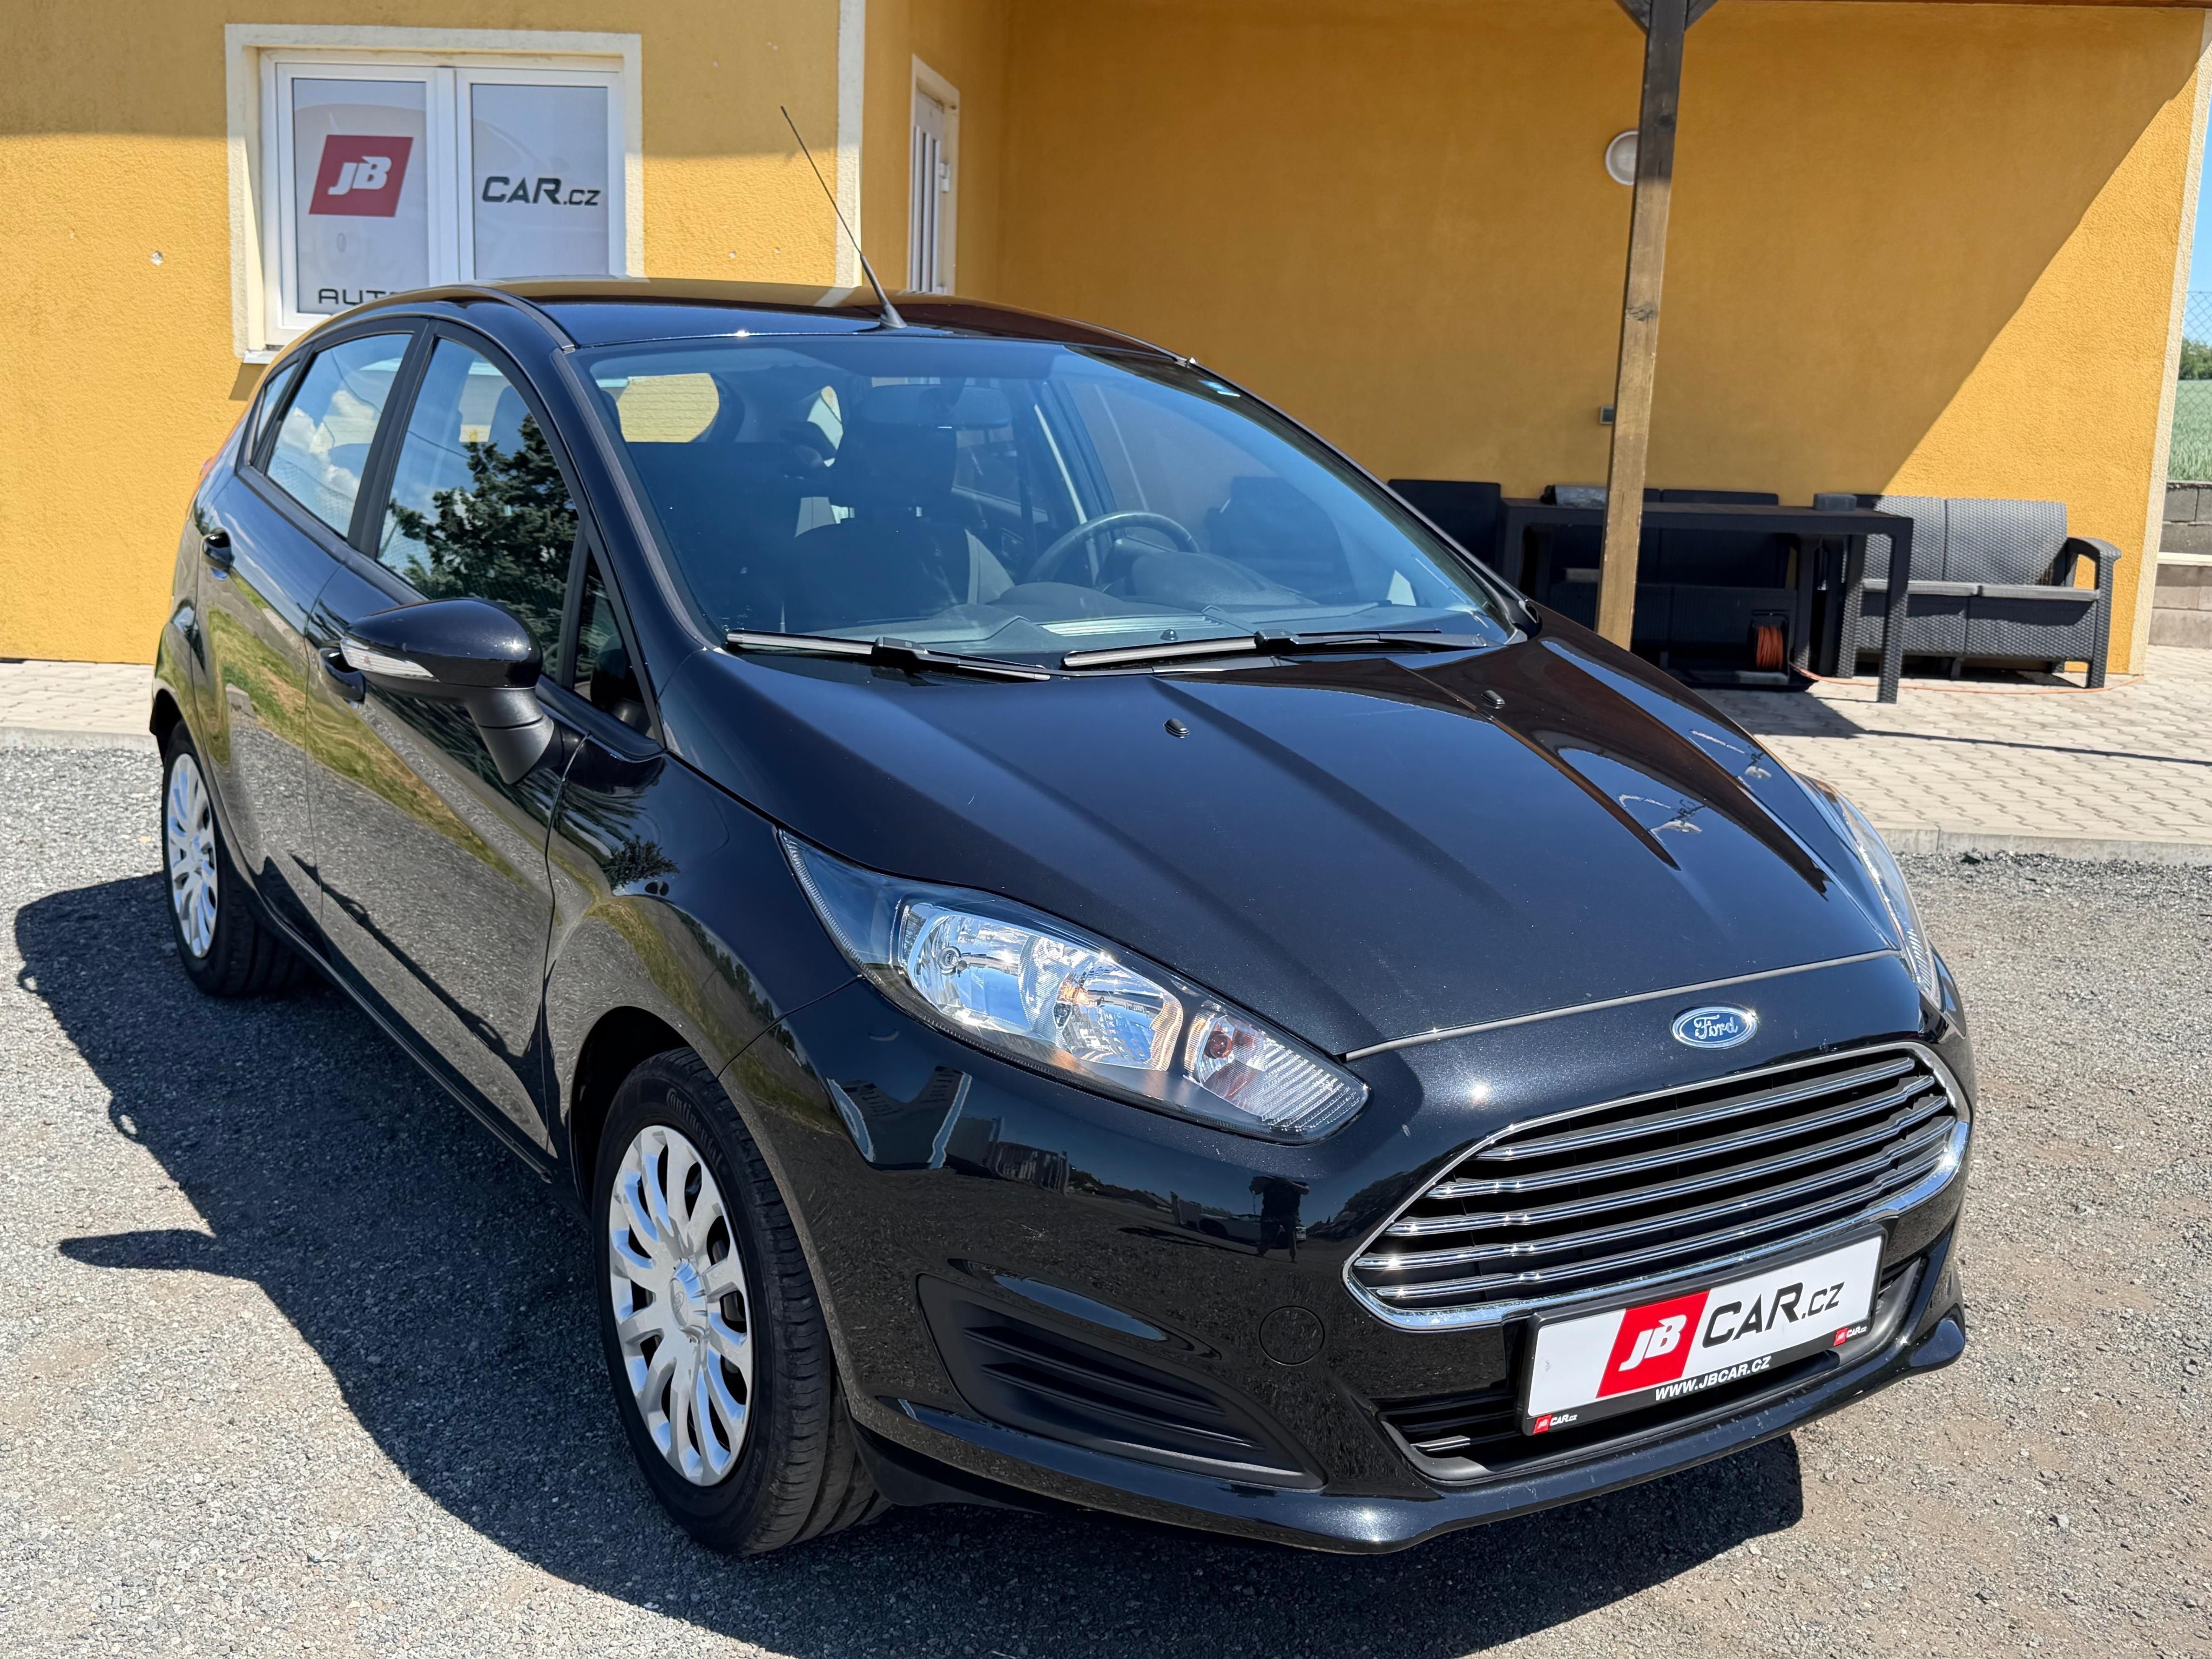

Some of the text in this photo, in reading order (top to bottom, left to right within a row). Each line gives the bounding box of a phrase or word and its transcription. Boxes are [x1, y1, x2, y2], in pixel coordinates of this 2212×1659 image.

[328, 156, 392, 195] JB
[319, 288, 399, 306] AUT
[1694, 1014, 1738, 1040] Ford
[1618, 1314, 1687, 1372] JB
[1655, 1355, 1771, 1401] WWW.JBCAR.CZ
